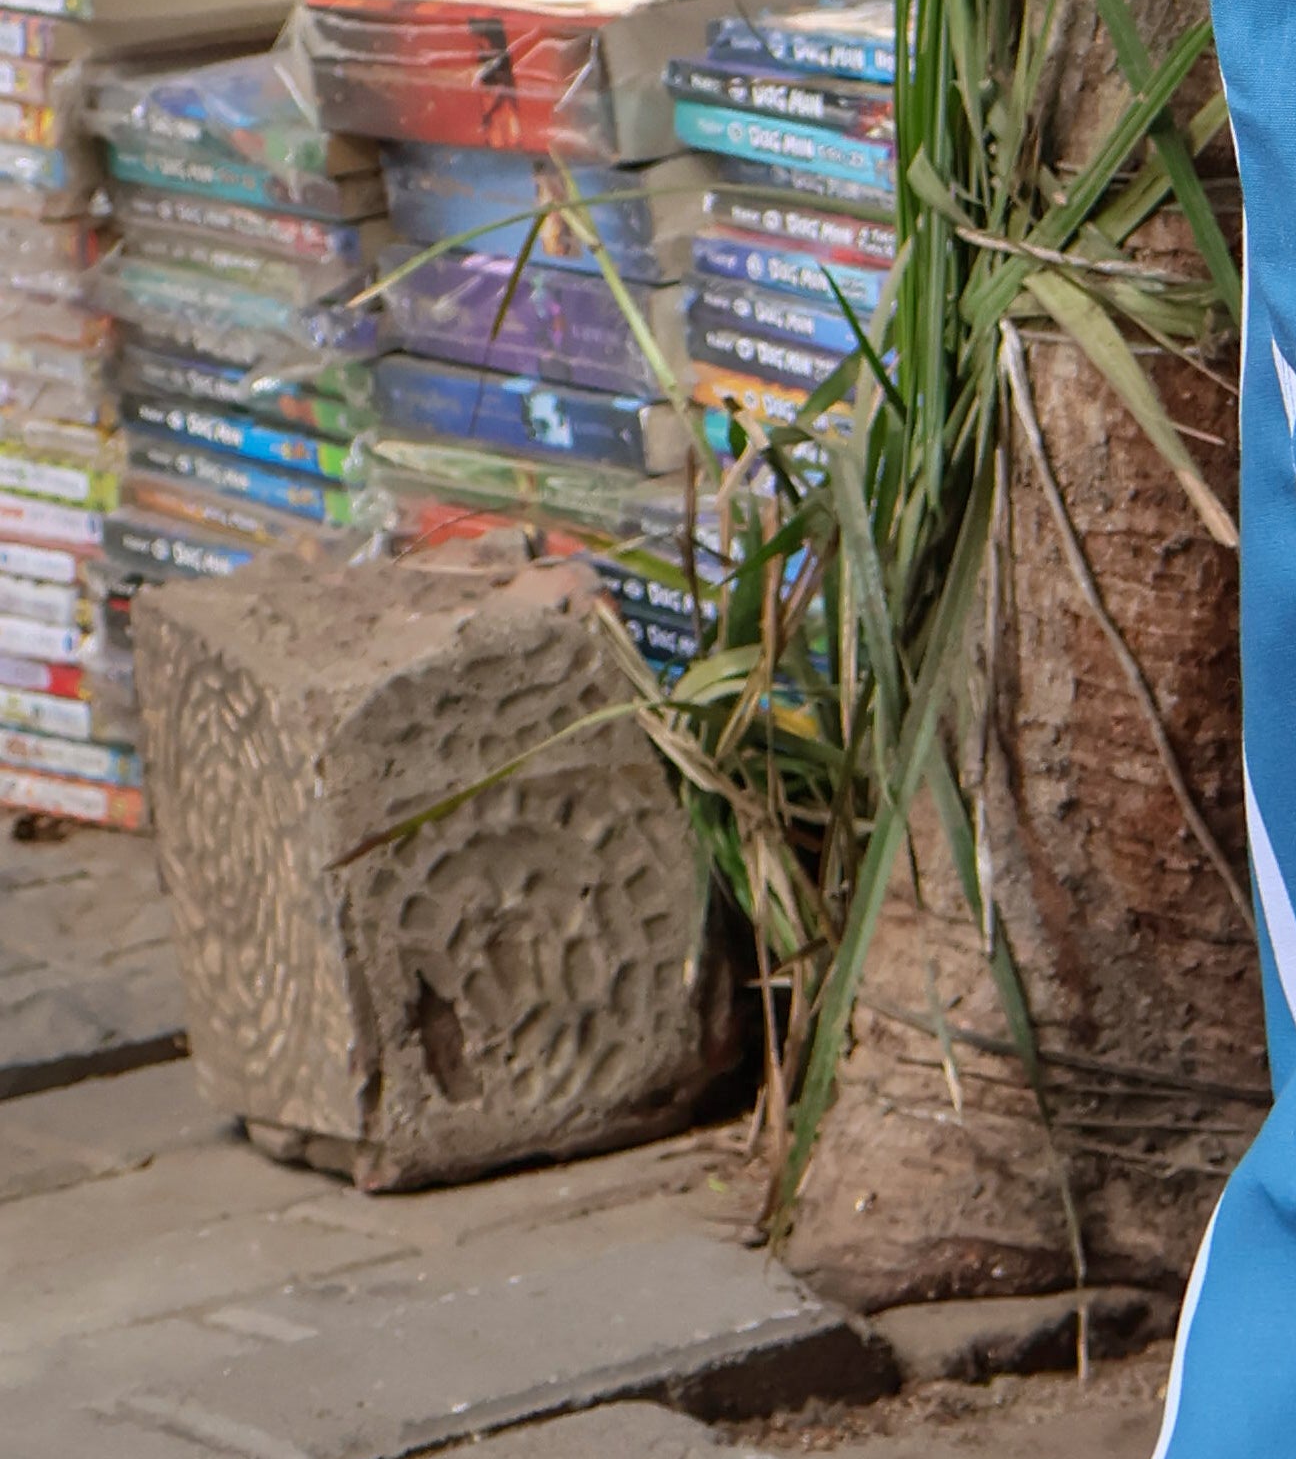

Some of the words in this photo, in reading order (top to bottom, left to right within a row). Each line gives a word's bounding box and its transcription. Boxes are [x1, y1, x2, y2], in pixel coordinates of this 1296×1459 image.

[752, 80, 788, 111] DOG
[748, 124, 782, 153] DOG
[784, 211, 820, 240] DOG
